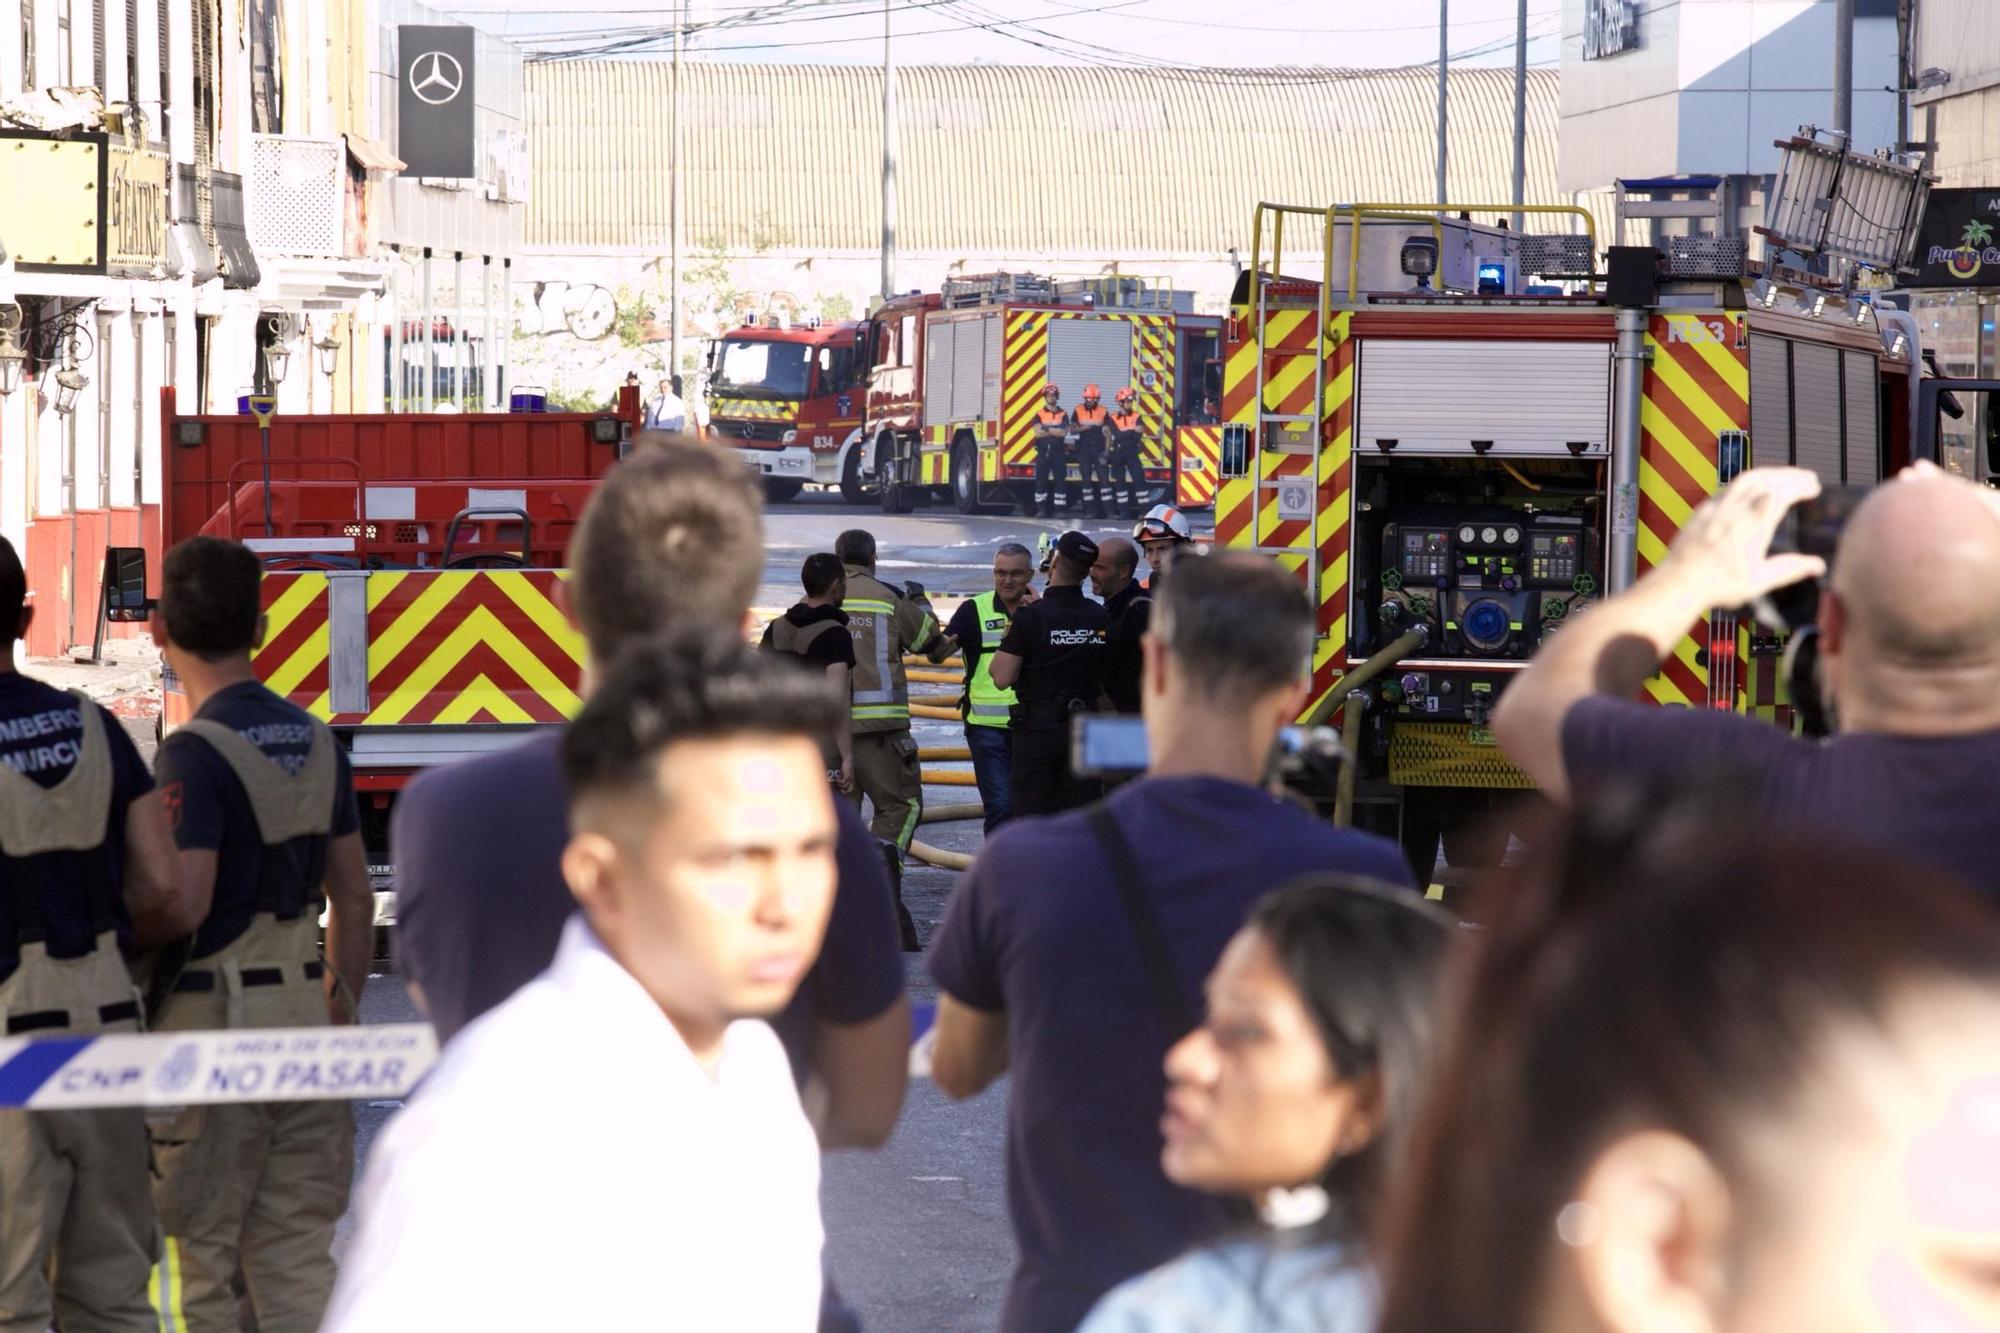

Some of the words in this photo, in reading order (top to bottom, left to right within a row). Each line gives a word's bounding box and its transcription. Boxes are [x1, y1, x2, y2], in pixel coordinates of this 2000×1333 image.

[1667, 321, 1725, 343] R53
[1593, 443, 1601, 452] 7
[1429, 698, 1435, 709] 1
[61, 1067, 142, 1092] CNP
[204, 1062, 265, 1093] NO
[275, 1056, 406, 1089] PASAR
